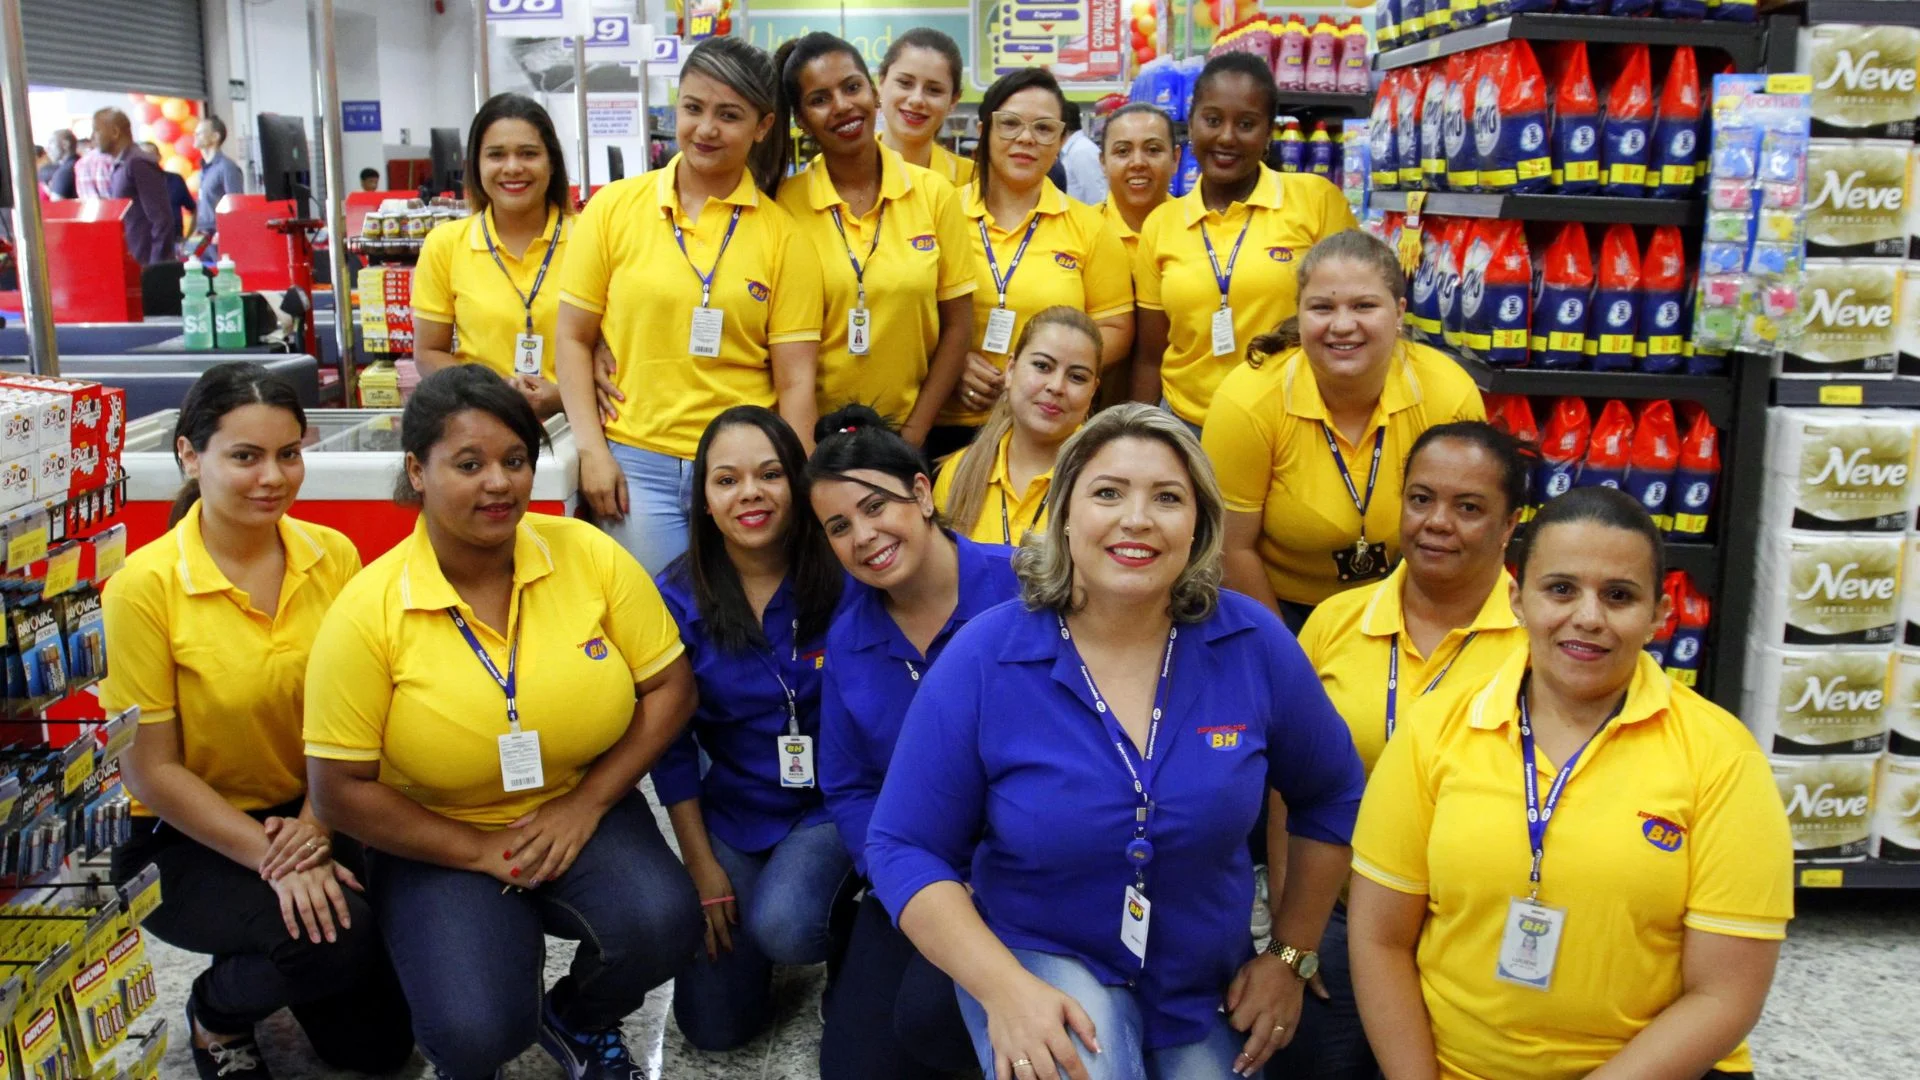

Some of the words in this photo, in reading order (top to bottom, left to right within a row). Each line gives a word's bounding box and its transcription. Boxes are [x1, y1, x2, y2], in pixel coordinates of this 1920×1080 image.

[691, 15, 713, 36] BH
[1815, 49, 1917, 92] Neve
[1802, 169, 1903, 210] Neve
[1797, 288, 1892, 328] Neve
[1806, 446, 1908, 487] Neve
[1796, 561, 1895, 601] Neve
[17, 608, 55, 638] RAYOVAC
[815, 656, 825, 670] B
[1785, 675, 1883, 712] Neve
[787, 744, 803, 753] BH
[1212, 731, 1238, 748] BH
[84, 759, 119, 792] RAYOVAC
[1786, 783, 1868, 818] Neve
[1647, 824, 1680, 848] BH
[1129, 902, 1143, 920] BH
[1521, 920, 1547, 935] BH
